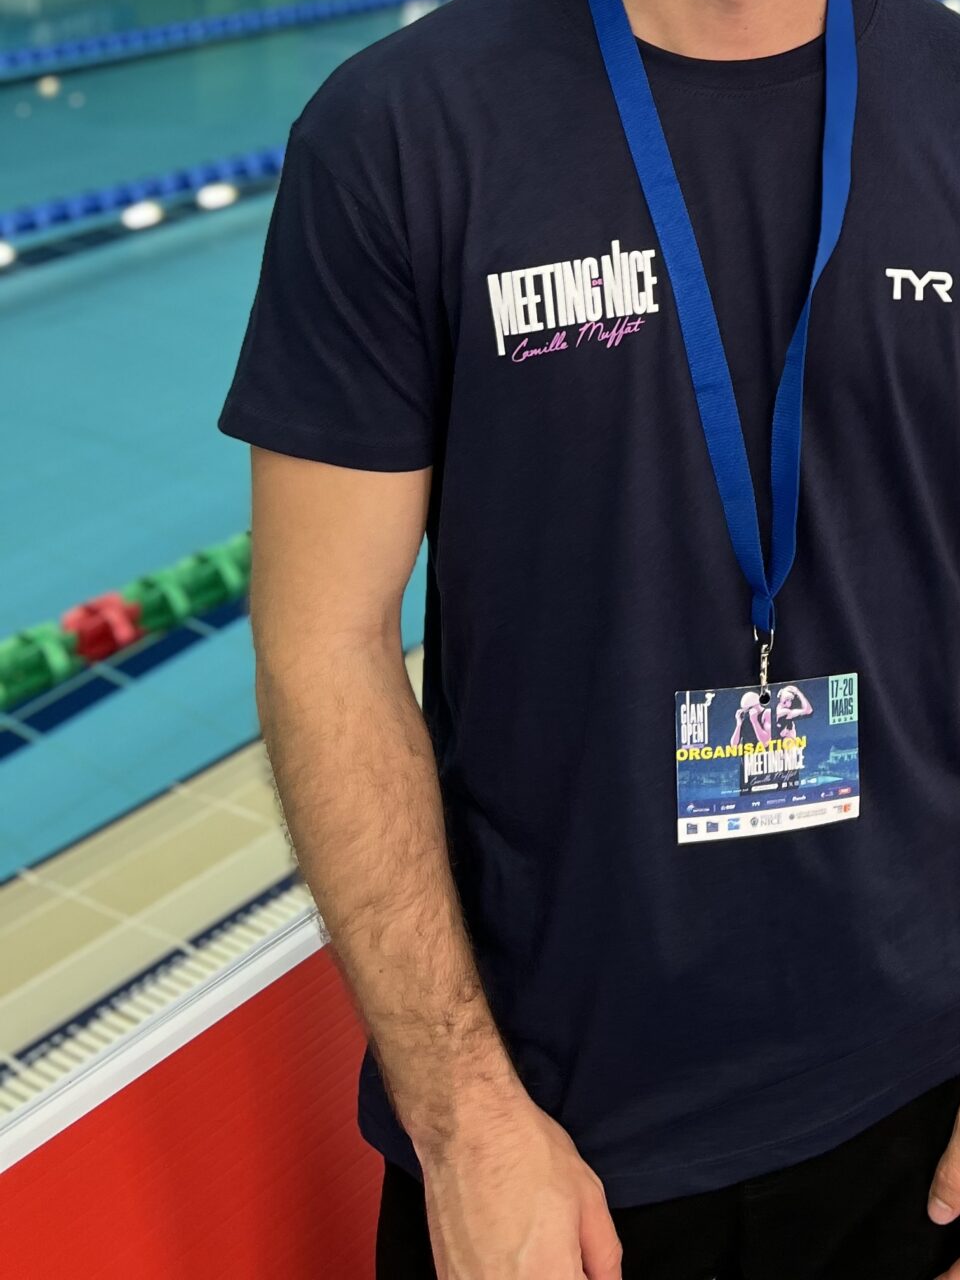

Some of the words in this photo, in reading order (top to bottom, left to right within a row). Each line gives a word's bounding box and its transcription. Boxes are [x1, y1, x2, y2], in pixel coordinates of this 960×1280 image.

[487, 256, 604, 356] MEETING
[601, 239, 660, 319] NICE
[885, 268, 953, 303] TYR
[512, 331, 568, 363] Camille
[576, 317, 645, 349] Muffat
[831, 677, 854, 698] 17-20
[681, 691, 710, 744] GIANT
[831, 697, 854, 718] MARS
[681, 722, 704, 745] OPEN
[676, 736, 807, 762] ORGANISATION
